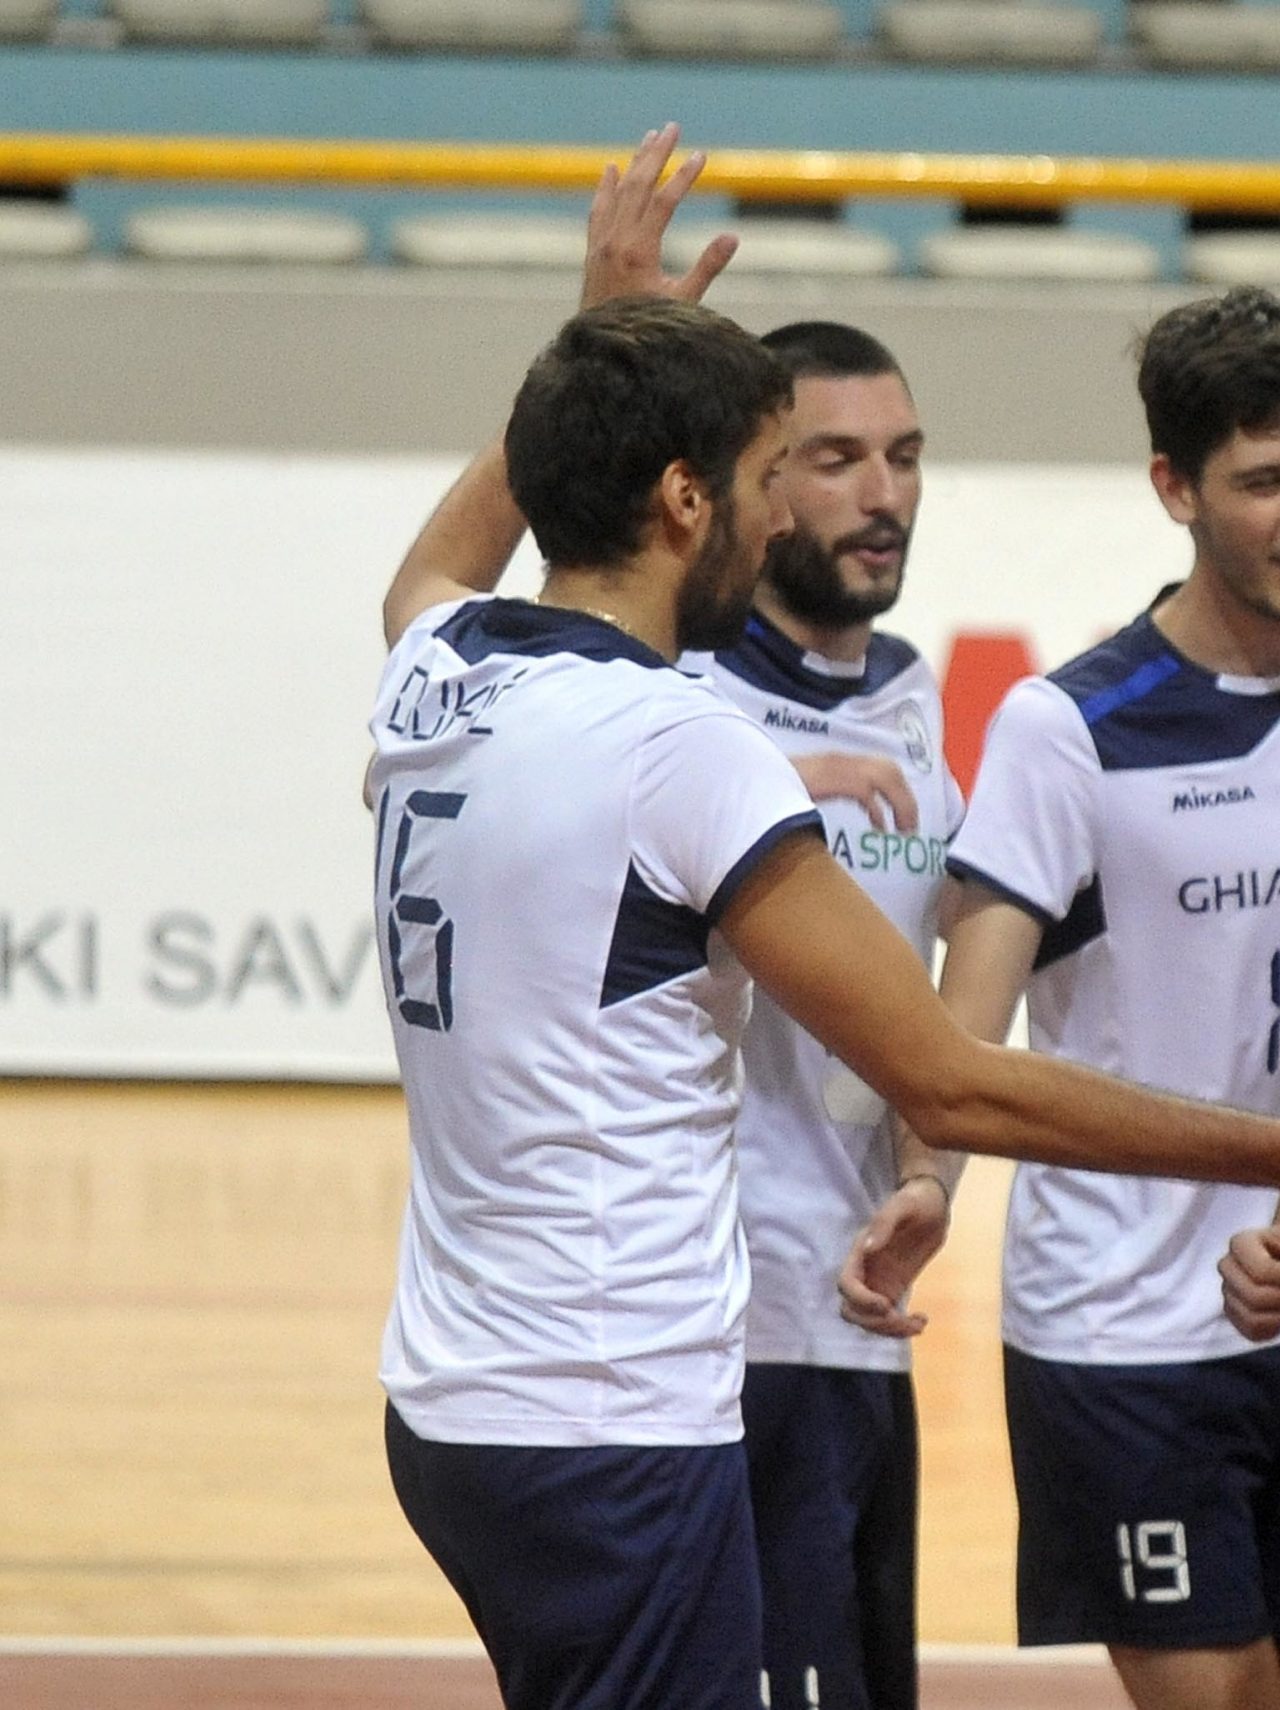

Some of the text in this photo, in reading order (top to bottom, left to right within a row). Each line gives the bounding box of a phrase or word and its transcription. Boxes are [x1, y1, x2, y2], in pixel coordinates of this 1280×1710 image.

[0, 908, 375, 1006] KI SAV
[1117, 1520, 1191, 1603] 19
